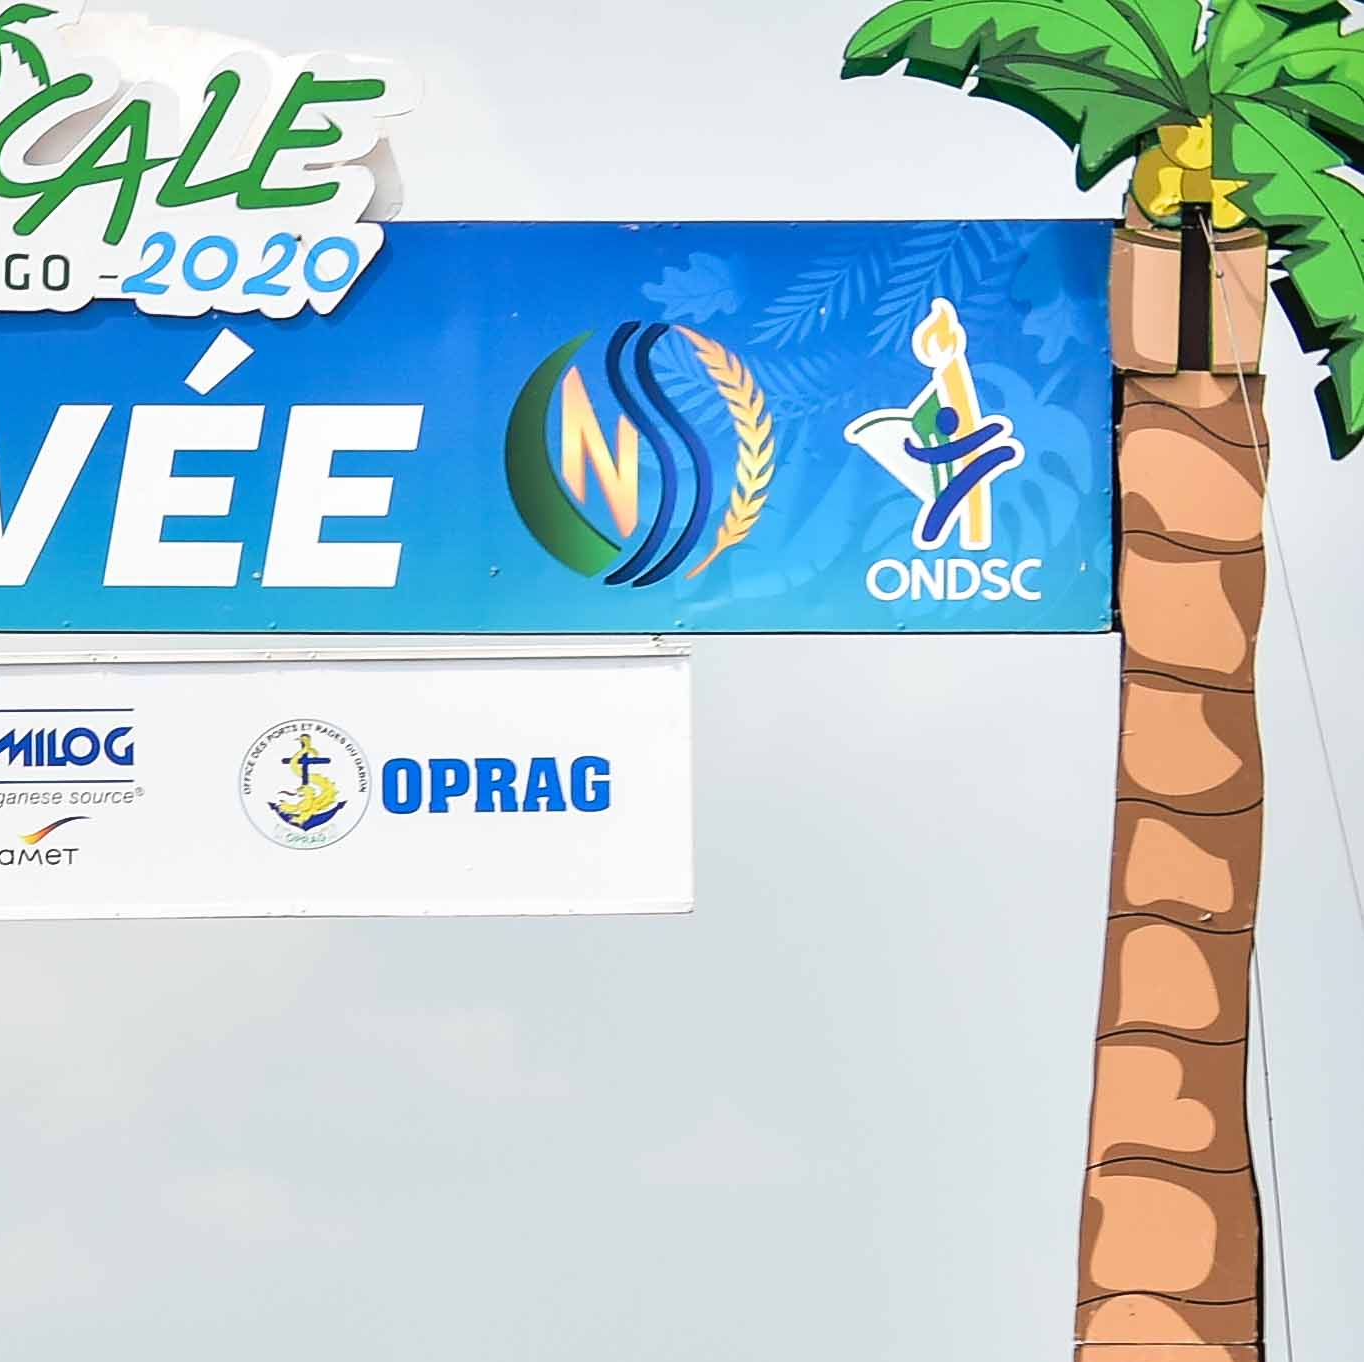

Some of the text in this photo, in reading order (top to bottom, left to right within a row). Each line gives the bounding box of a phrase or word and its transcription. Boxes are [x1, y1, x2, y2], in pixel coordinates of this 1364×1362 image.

[123, 231, 360, 295] 2020
[866, 557, 1042, 602] ONDSC
[381, 755, 612, 816] OPRAG
